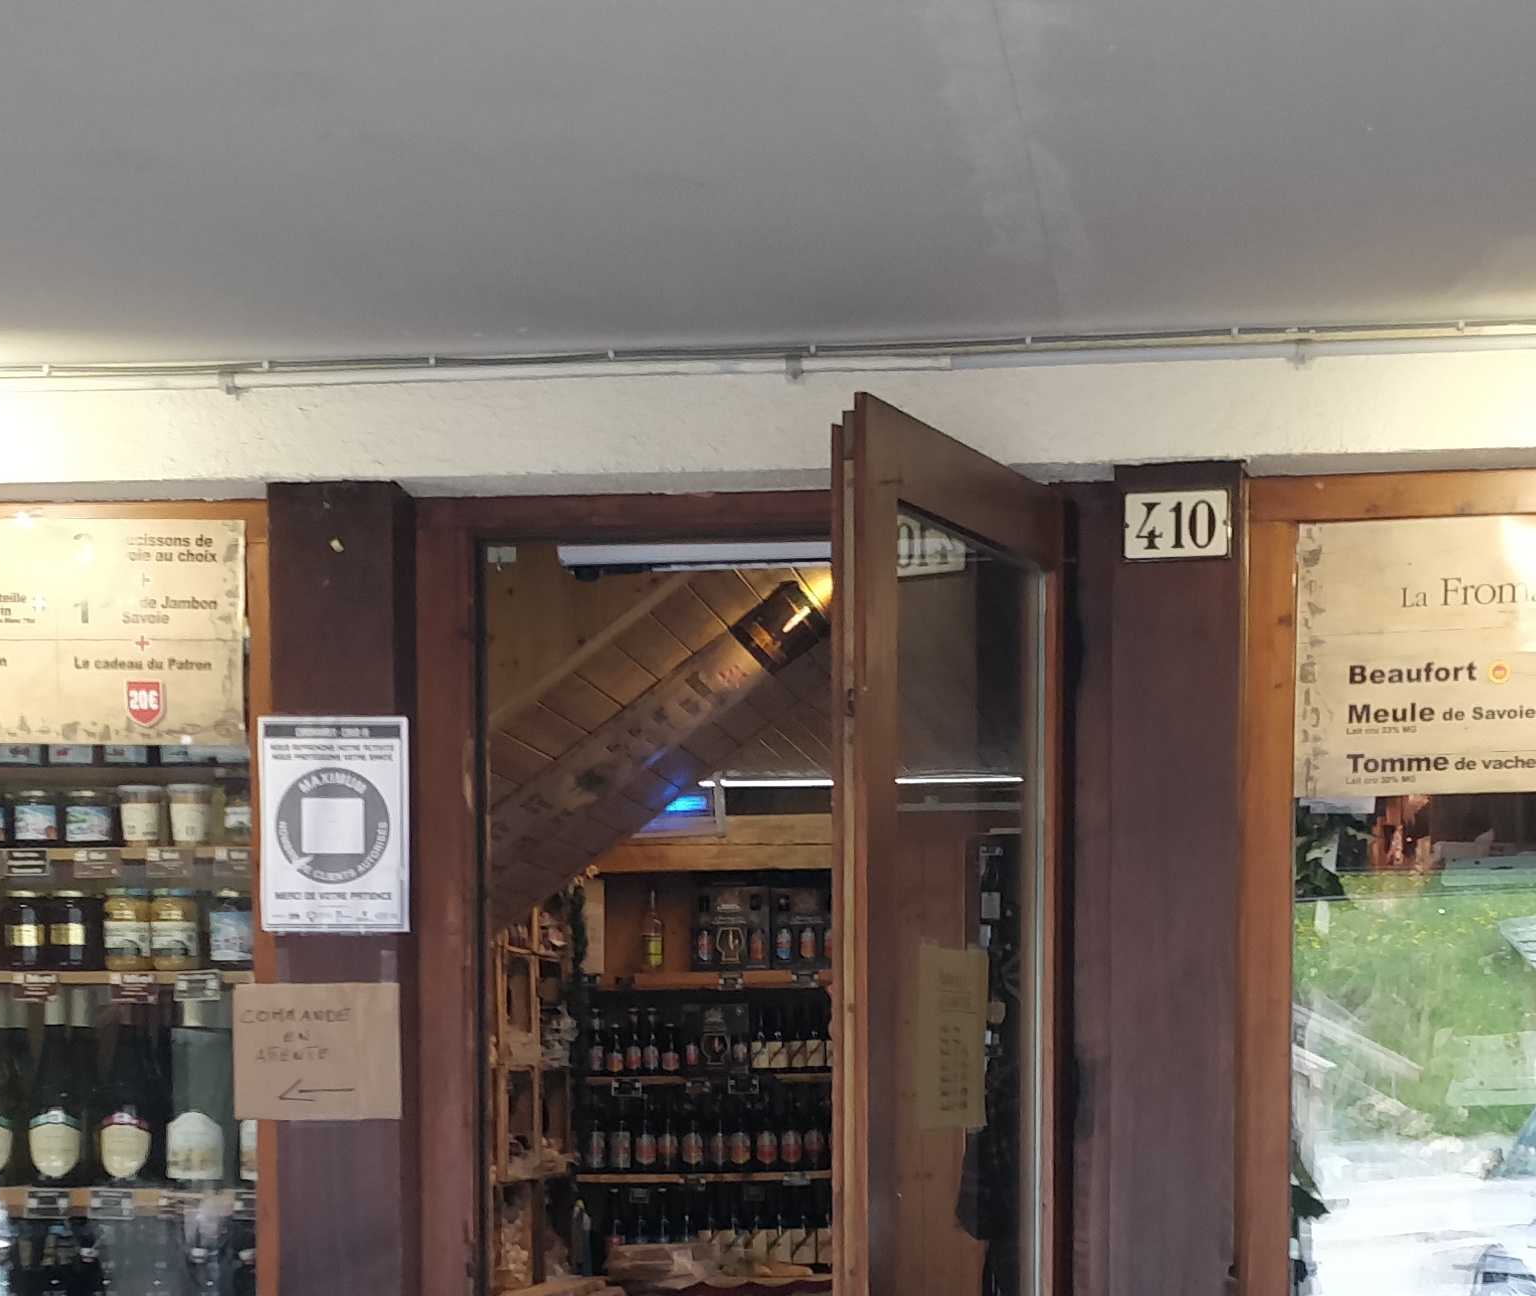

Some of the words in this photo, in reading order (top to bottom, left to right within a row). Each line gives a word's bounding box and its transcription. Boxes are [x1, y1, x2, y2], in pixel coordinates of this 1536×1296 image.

[1135, 500, 1216, 550] 410
[195, 534, 213, 547] de
[155, 552, 173, 562] au
[177, 549, 218, 563] choix
[140, 597, 157, 609] de
[161, 596, 218, 610] Jambon
[1401, 587, 1428, 608] La
[122, 611, 170, 624] Savoie
[74, 656, 90, 670] Le
[95, 657, 143, 670] cadeau
[147, 658, 164, 671] du
[168, 658, 212, 671] Patron
[1349, 661, 1478, 685] Beaufort
[129, 690, 159, 711] 20€
[1348, 703, 1436, 724] Meule
[1442, 707, 1466, 721] de
[1471, 705, 1536, 720] Savoie
[1347, 753, 1450, 775] Tomme
[1454, 757, 1478, 771] de
[1481, 755, 1536, 771] vache
[298, 771, 368, 794] MAXIMUM
[239, 1007, 352, 1024] COMMANDE
[283, 1031, 310, 1042] EN
